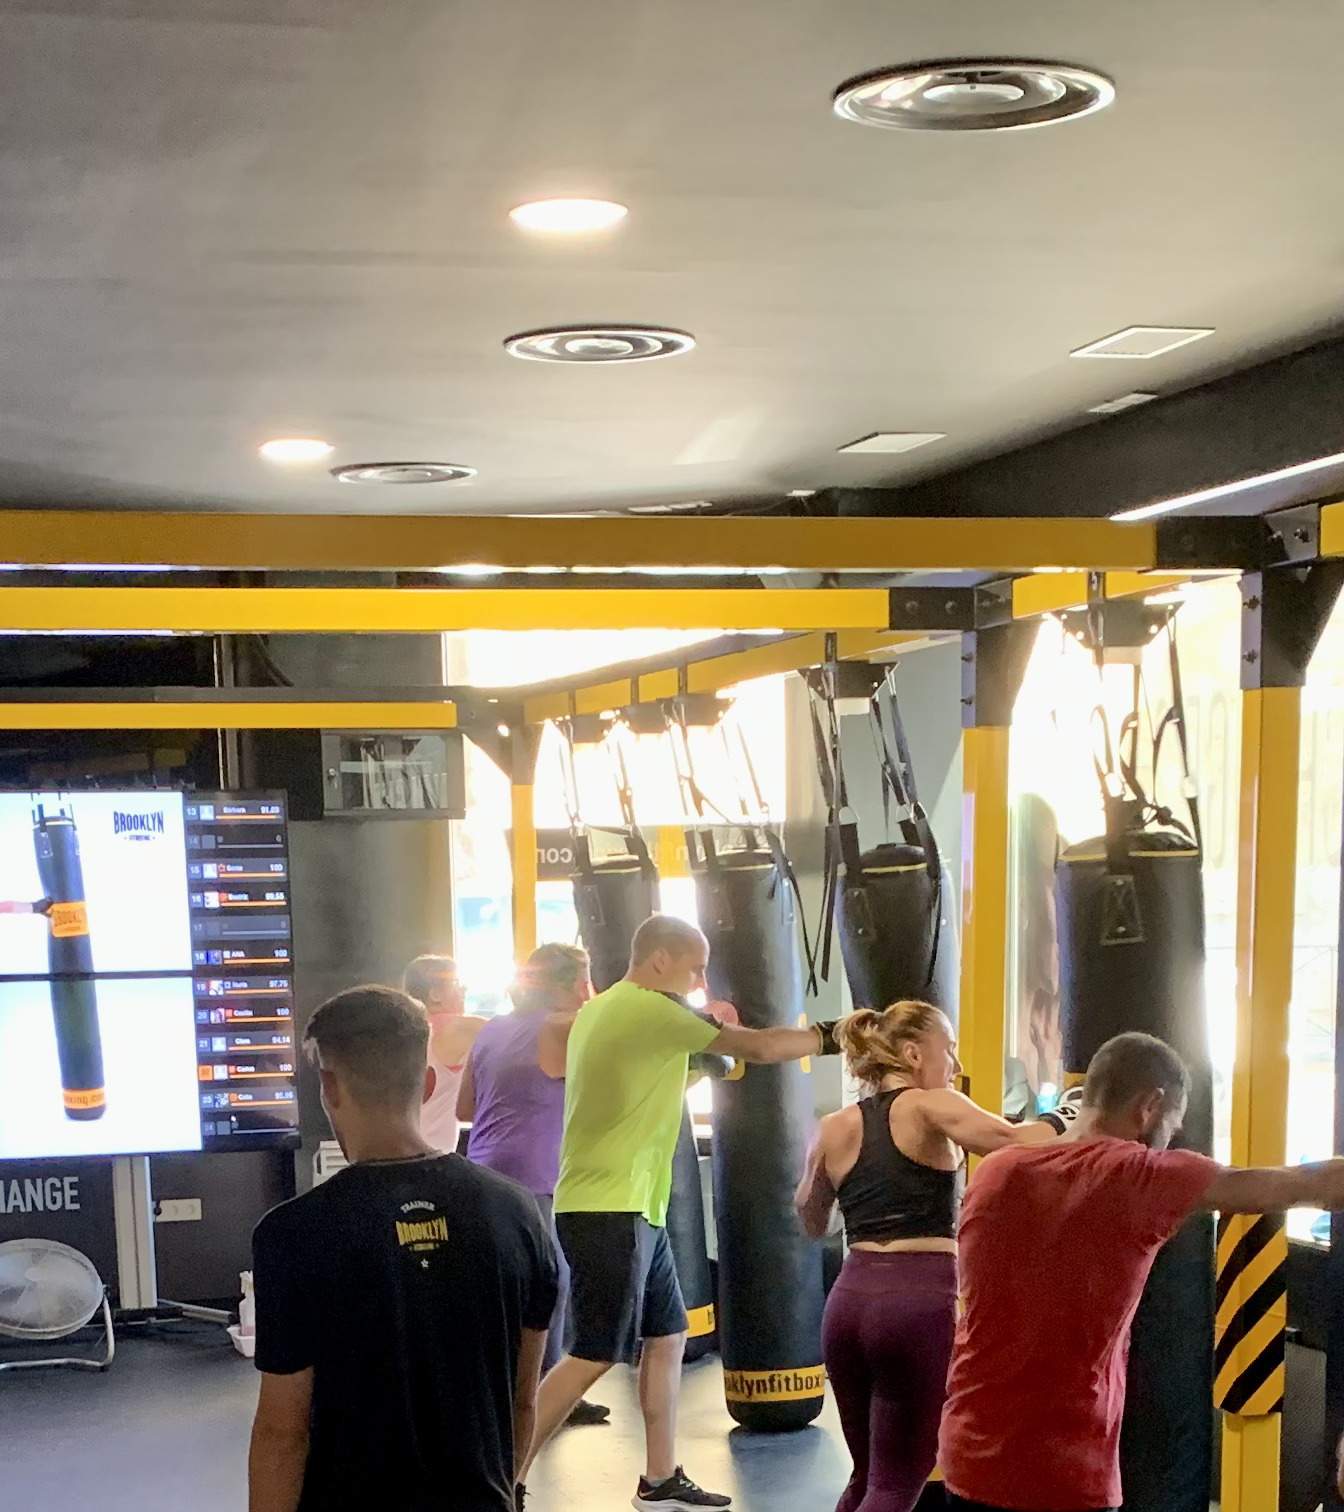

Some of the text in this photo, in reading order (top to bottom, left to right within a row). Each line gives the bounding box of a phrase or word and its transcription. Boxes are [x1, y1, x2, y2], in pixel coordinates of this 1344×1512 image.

[113, 811, 164, 834] BROOKLYN
[276, 1008, 290, 1016] 100
[396, 1216, 449, 1246] BROOKLYN
